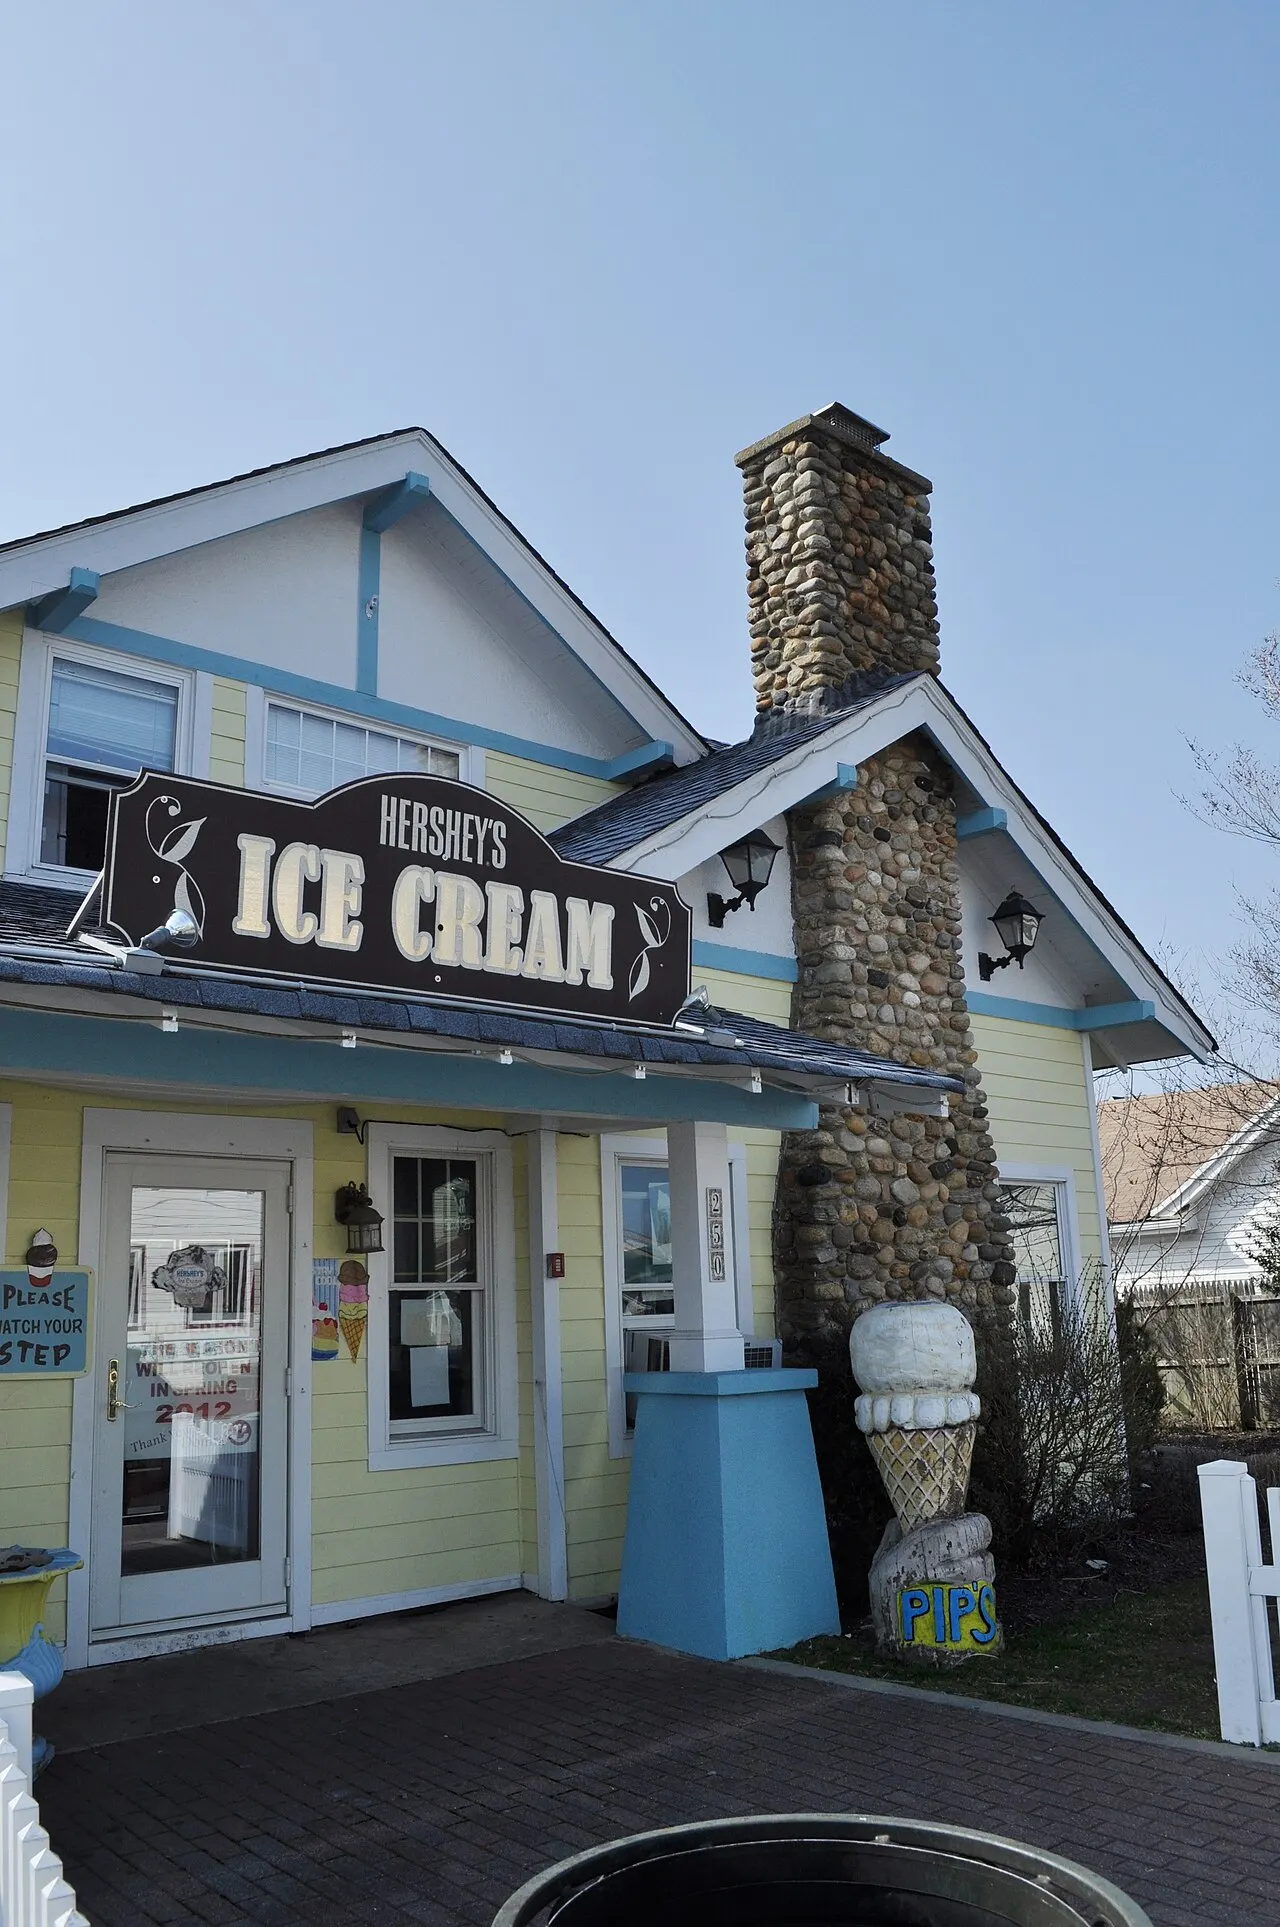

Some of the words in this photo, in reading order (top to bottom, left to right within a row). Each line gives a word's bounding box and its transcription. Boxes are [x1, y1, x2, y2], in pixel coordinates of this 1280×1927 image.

[380, 794, 507, 870] HERSHEY'S
[232, 833, 366, 952] ICE
[391, 864, 615, 991] CREAM
[710, 1191, 723, 1276] 250
[3, 1284, 75, 1313] PLEASE
[0, 1319, 40, 1335] ATCH
[44, 1319, 83, 1335] YOUR
[0, 1340, 71, 1366] STEP
[150, 1382, 169, 1397] IN
[155, 1401, 231, 1424] 2012
[130, 1432, 167, 1453] Thank
[901, 1581, 997, 1644] PIP'S
